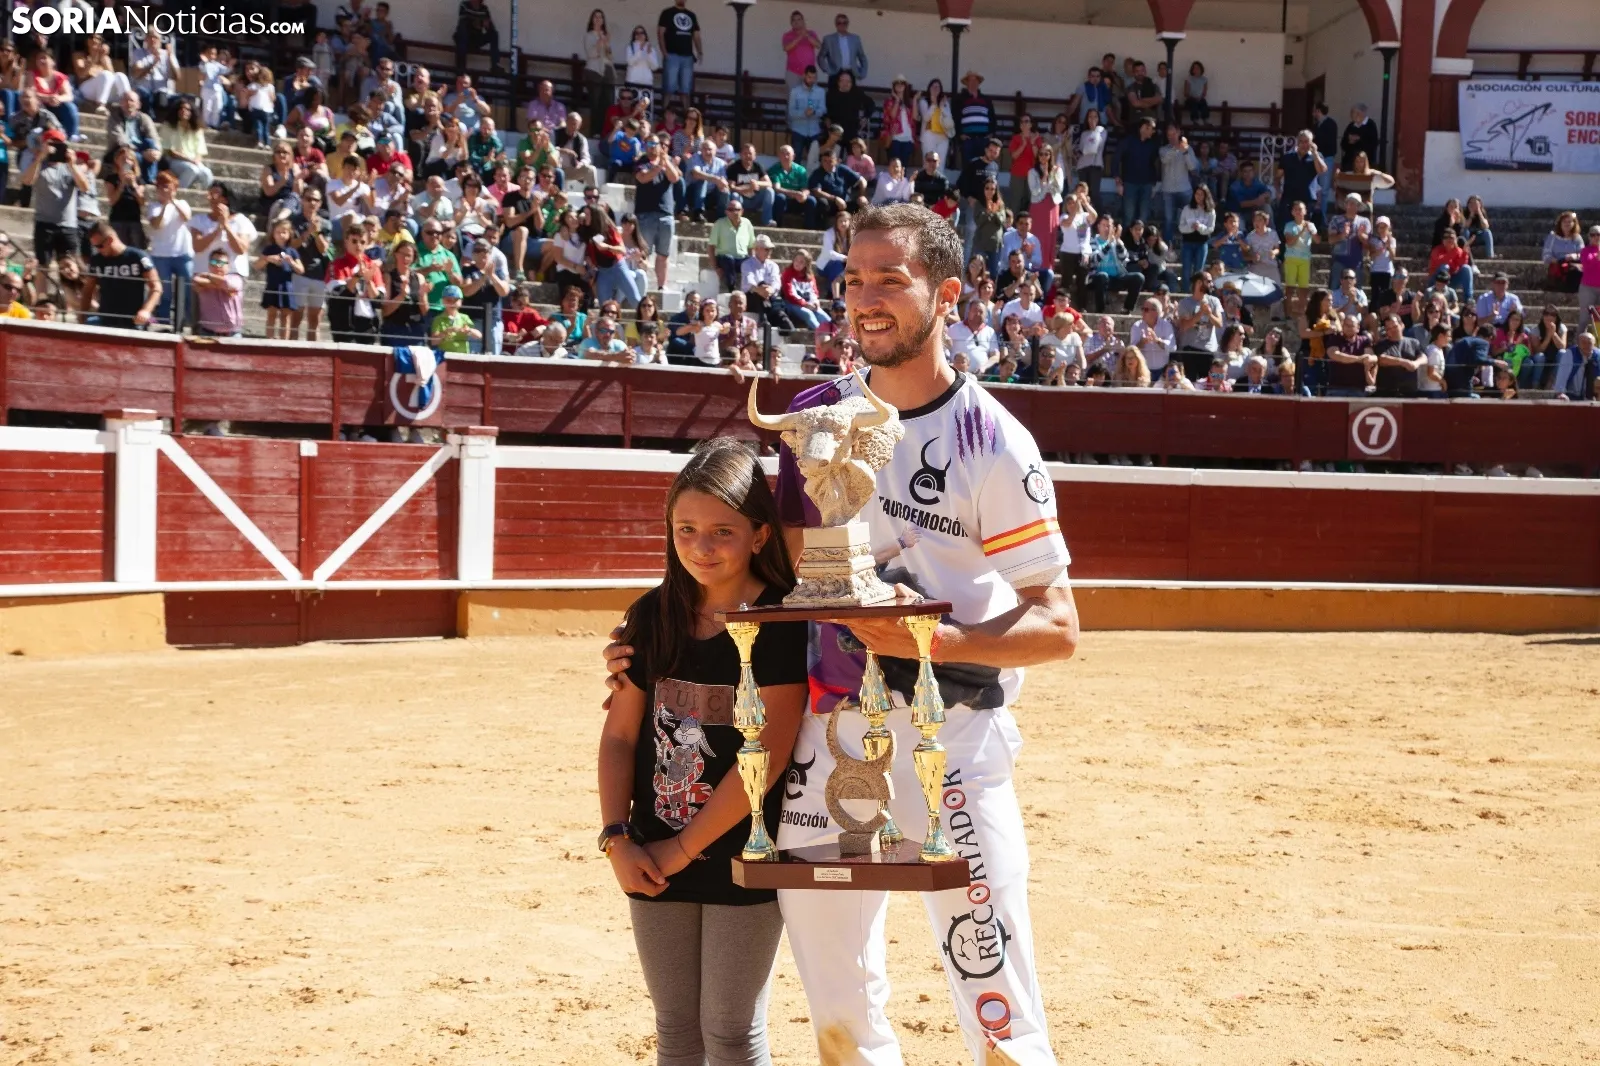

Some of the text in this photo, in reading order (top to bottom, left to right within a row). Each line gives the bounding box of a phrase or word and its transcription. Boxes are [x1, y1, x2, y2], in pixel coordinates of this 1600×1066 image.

[1466, 82, 1542, 93] ASOCIACIÓN
[1567, 129, 1600, 144] ENC
[1365, 416, 1385, 446] 7
[781, 809, 829, 829] EMOCIÓN
